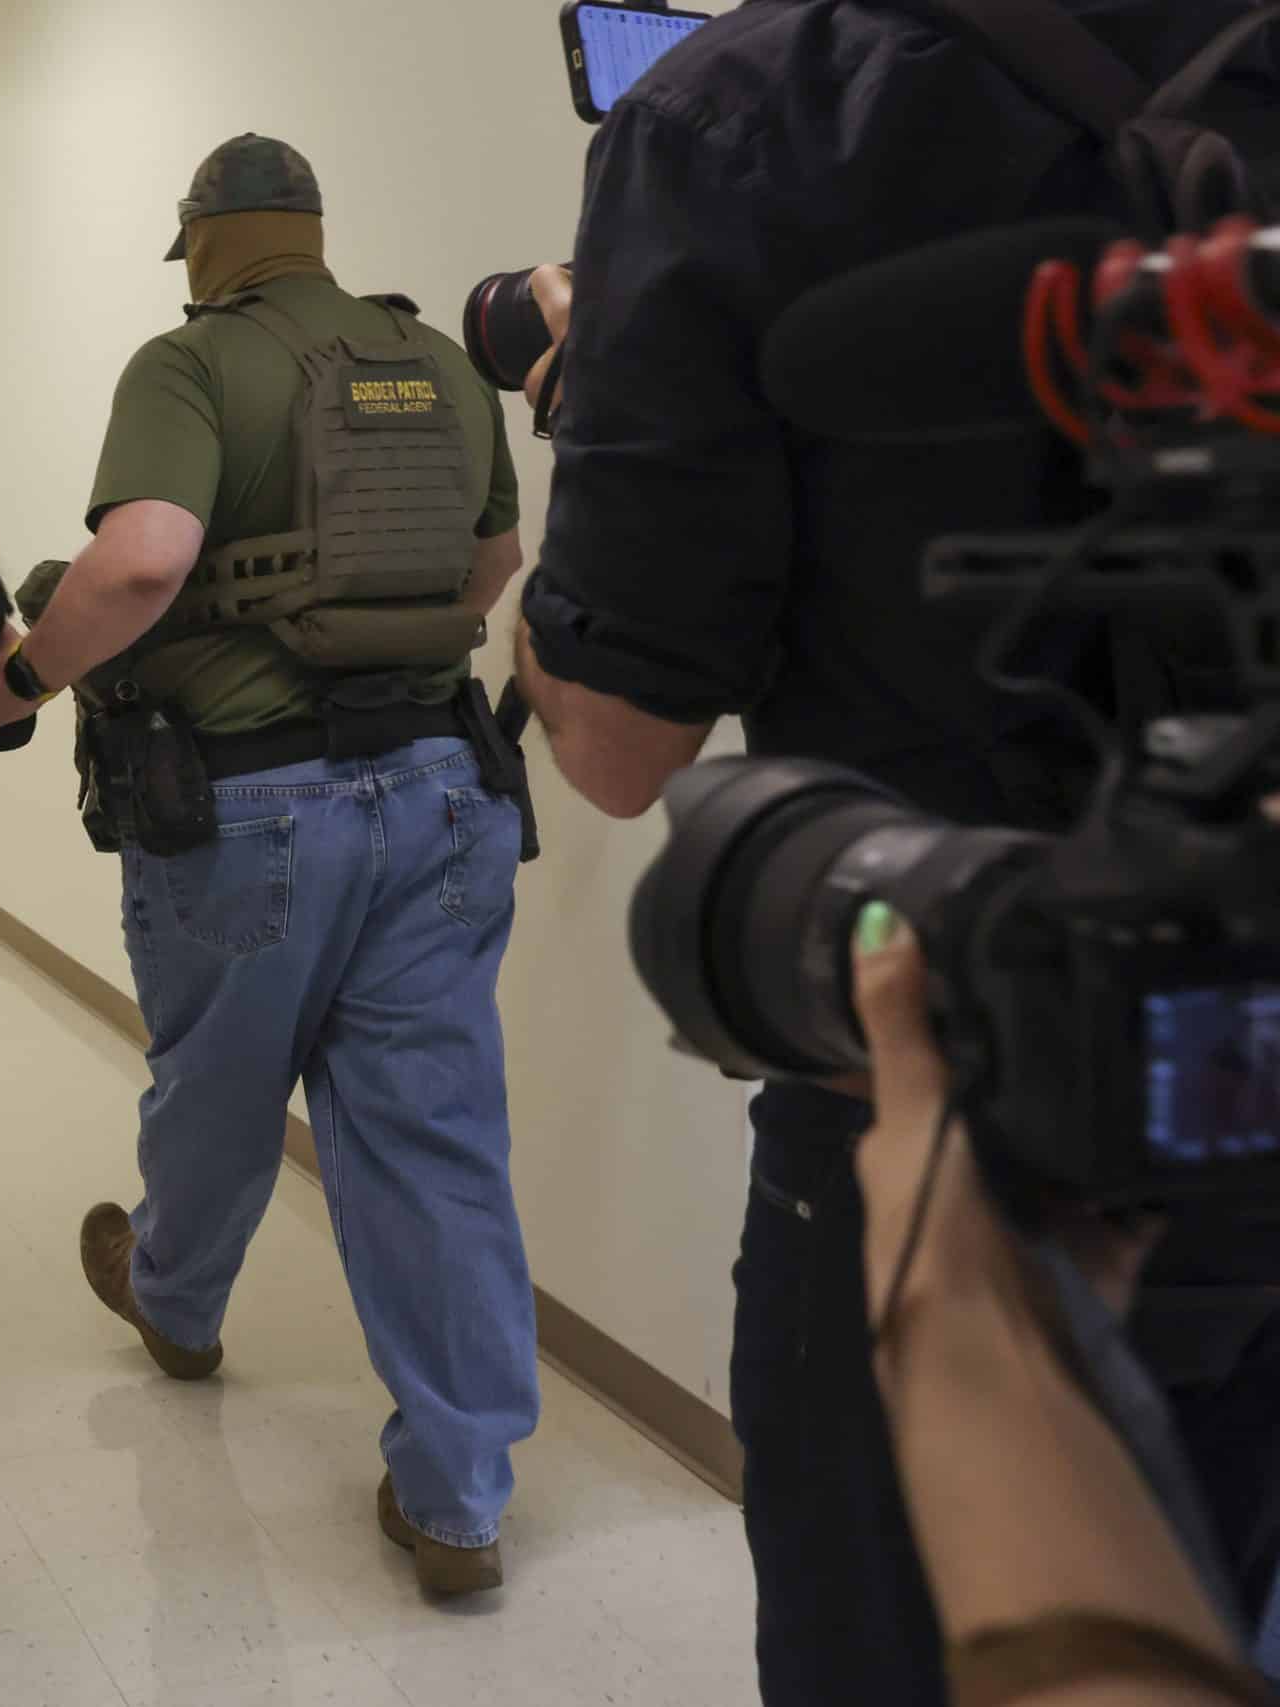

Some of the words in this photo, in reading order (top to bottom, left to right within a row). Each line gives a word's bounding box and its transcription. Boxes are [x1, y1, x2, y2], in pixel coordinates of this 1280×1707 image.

[351, 381, 395, 401] BORDER
[396, 381, 437, 400] PATROL
[359, 402, 402, 414] FEDERAL
[403, 401, 433, 413] AGENT
